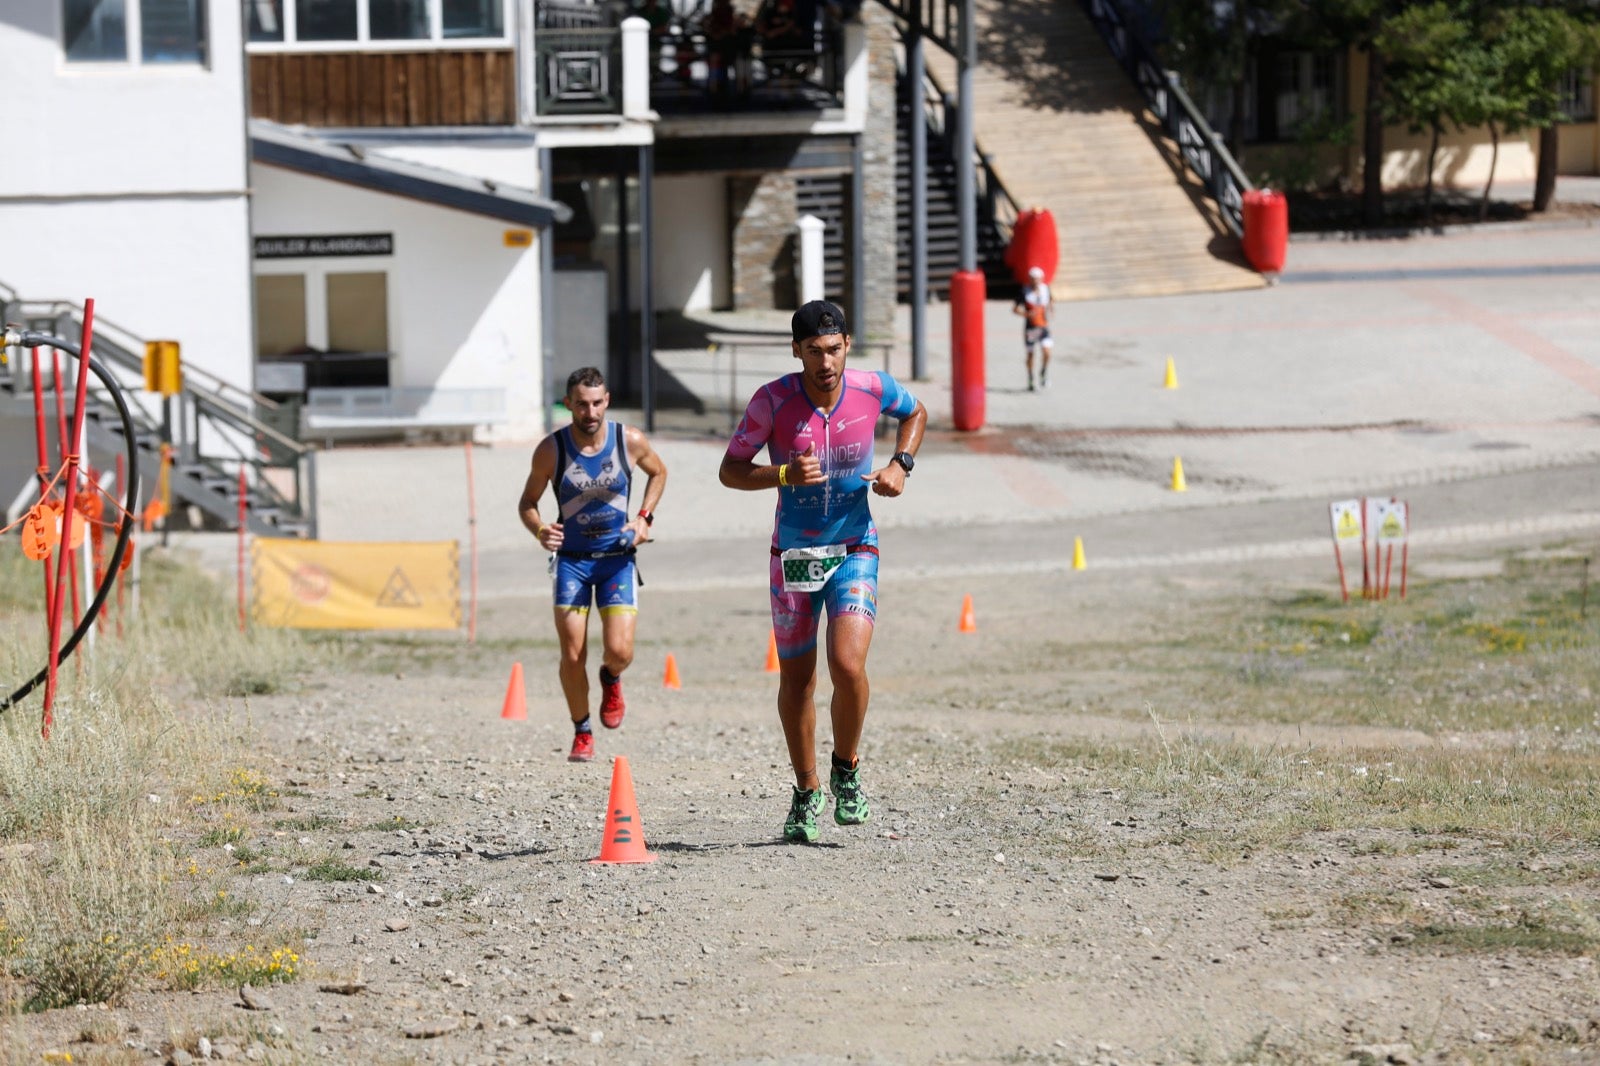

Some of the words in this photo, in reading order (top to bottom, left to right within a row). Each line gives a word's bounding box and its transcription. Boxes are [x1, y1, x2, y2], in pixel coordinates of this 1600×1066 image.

[788, 442, 861, 465] FENÁNDEZ
[576, 477, 619, 490] XARLÓN
[808, 561, 824, 580] 6
